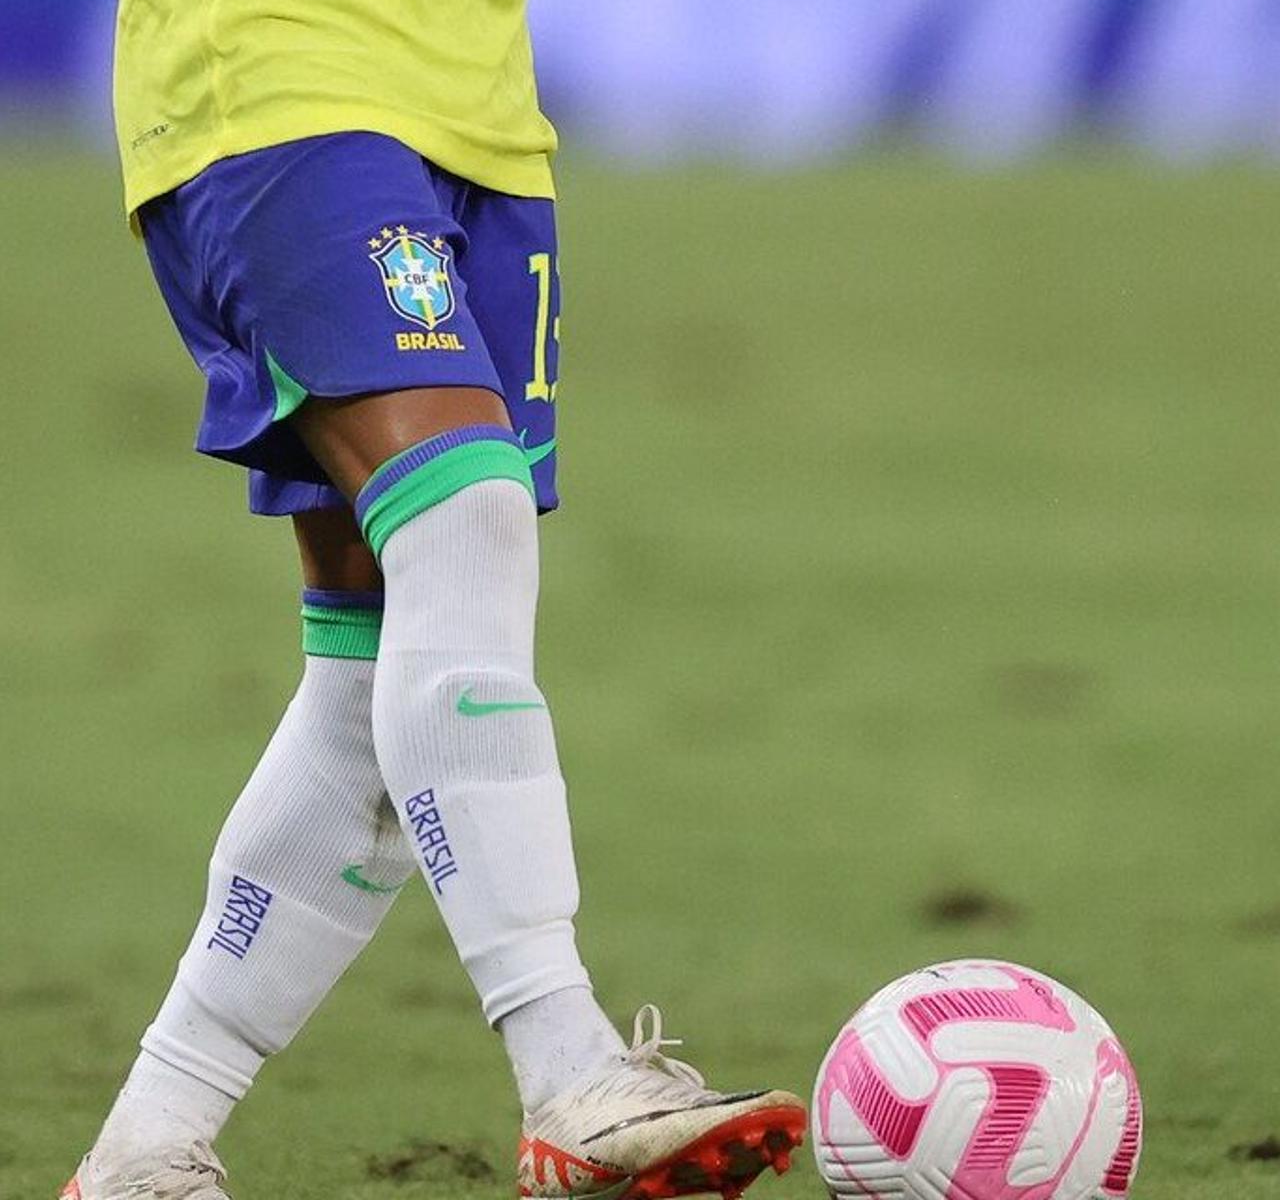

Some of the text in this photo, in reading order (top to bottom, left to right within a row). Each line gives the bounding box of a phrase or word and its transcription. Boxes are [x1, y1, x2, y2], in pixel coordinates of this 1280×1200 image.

[403, 271, 430, 285] CBF
[395, 332, 465, 351] BRASIL
[525, 253, 561, 402] 1
[404, 788, 459, 896] BRASIL
[207, 875, 274, 960] BRASIL
